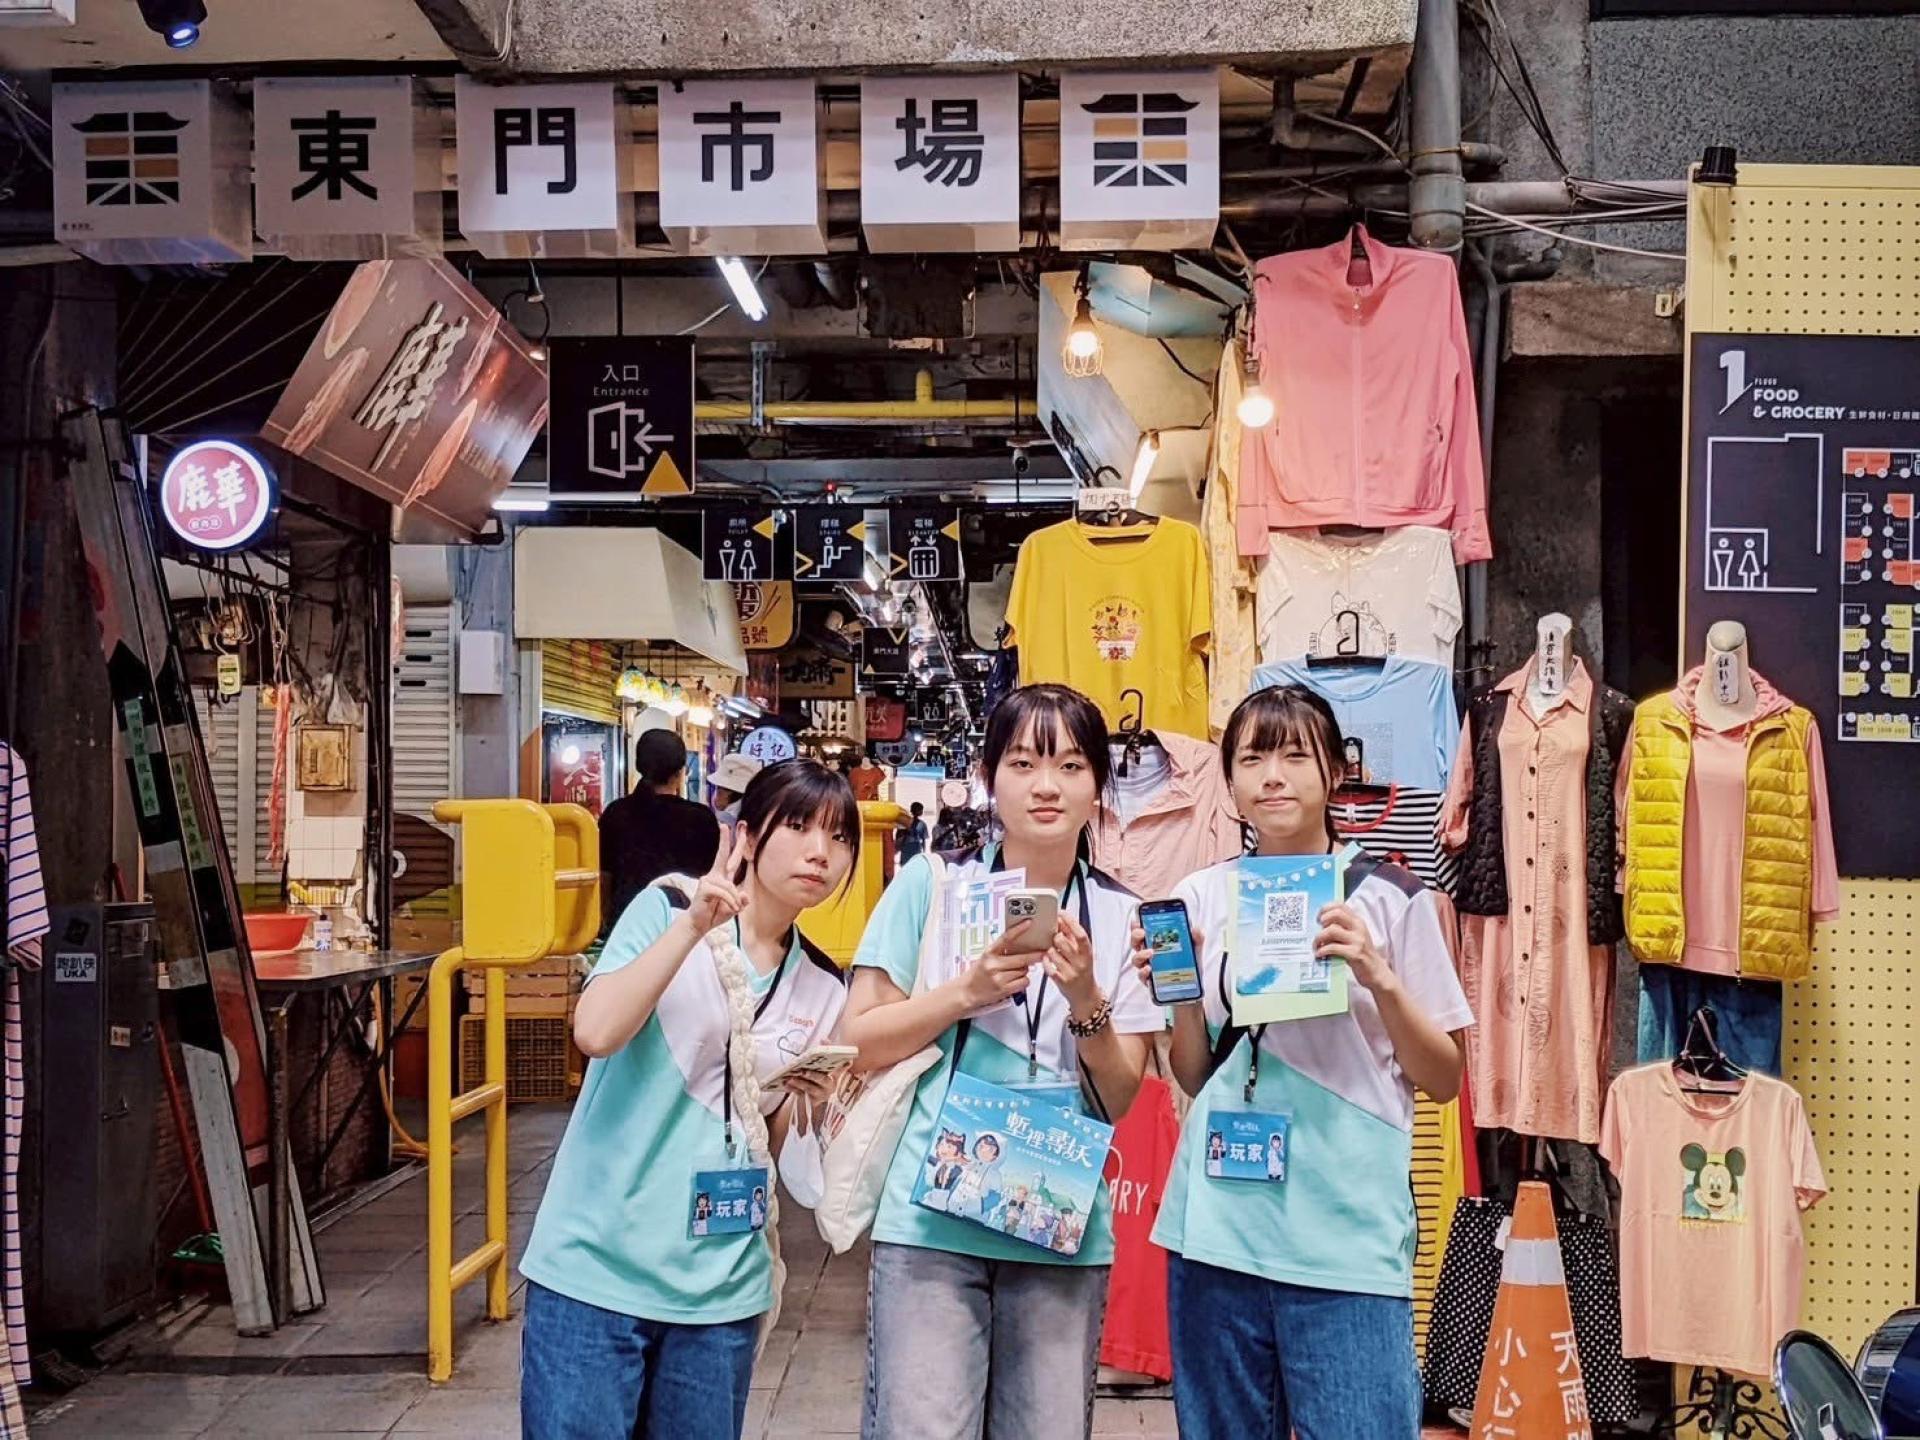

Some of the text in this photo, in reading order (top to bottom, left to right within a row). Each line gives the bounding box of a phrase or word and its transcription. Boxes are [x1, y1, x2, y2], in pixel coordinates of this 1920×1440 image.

[290, 98, 986, 201] 東門市場
[602, 364, 639, 382] 入口
[593, 386, 650, 397] Entrance
[1753, 389, 1800, 402] FOOD
[1753, 405, 1846, 420] & GROCERY
[1230, 1143, 1265, 1162] 玩家
[715, 1198, 748, 1218] 玩家
